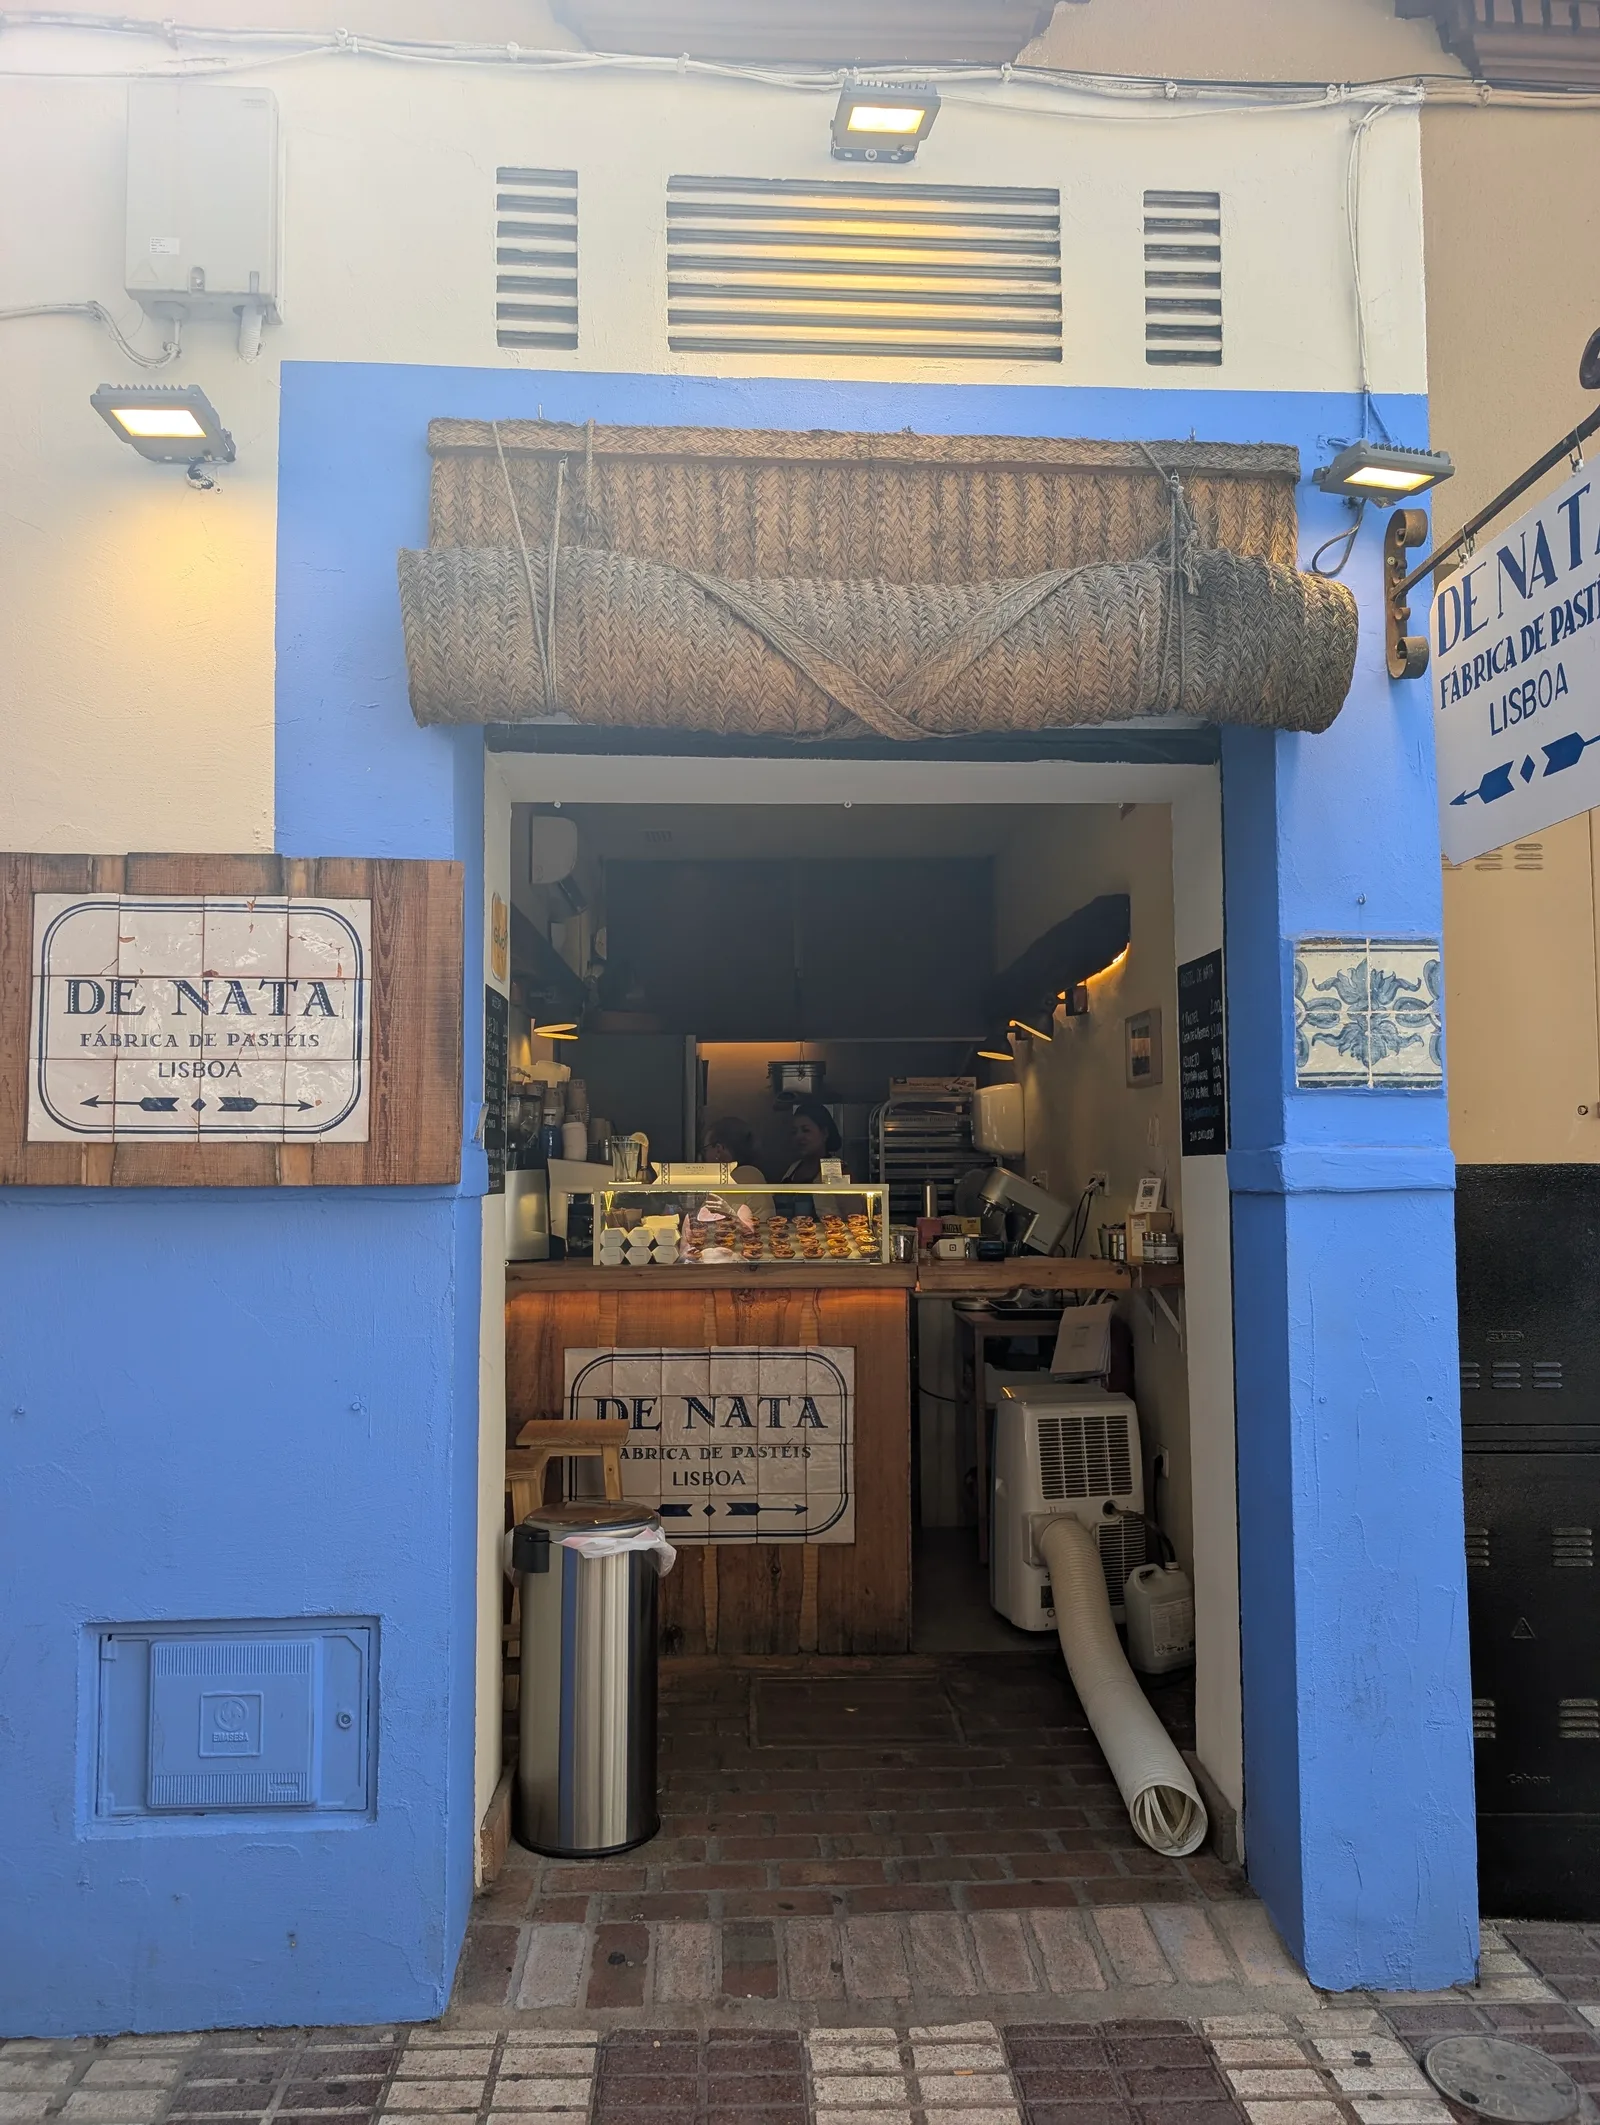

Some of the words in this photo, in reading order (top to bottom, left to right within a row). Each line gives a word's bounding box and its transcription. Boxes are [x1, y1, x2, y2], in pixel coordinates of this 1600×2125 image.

[1437, 561, 1490, 658] DE
[1496, 482, 1600, 620] NAT
[1440, 635, 1517, 710] FÁBRICA
[1521, 613, 1547, 661] DE
[1550, 573, 1600, 648] PAST
[1490, 662, 1568, 736] LISBOA
[64, 978, 146, 1016] DE
[167, 978, 339, 1017] NATA
[80, 1024, 177, 1048] FÁBRICA
[189, 1032, 217, 1048] DE
[227, 1025, 320, 1048] PASTÉIS
[158, 1061, 242, 1079] LISBOA
[593, 1396, 662, 1432] DE
[681, 1396, 828, 1429] NATA
[619, 1439, 691, 1460] ÁBRICA
[700, 1446, 723, 1460] DE
[731, 1438, 812, 1459] PASTÉIS
[672, 1470, 746, 1487] LISBOA
[212, 1732, 249, 1743] EMASESA
